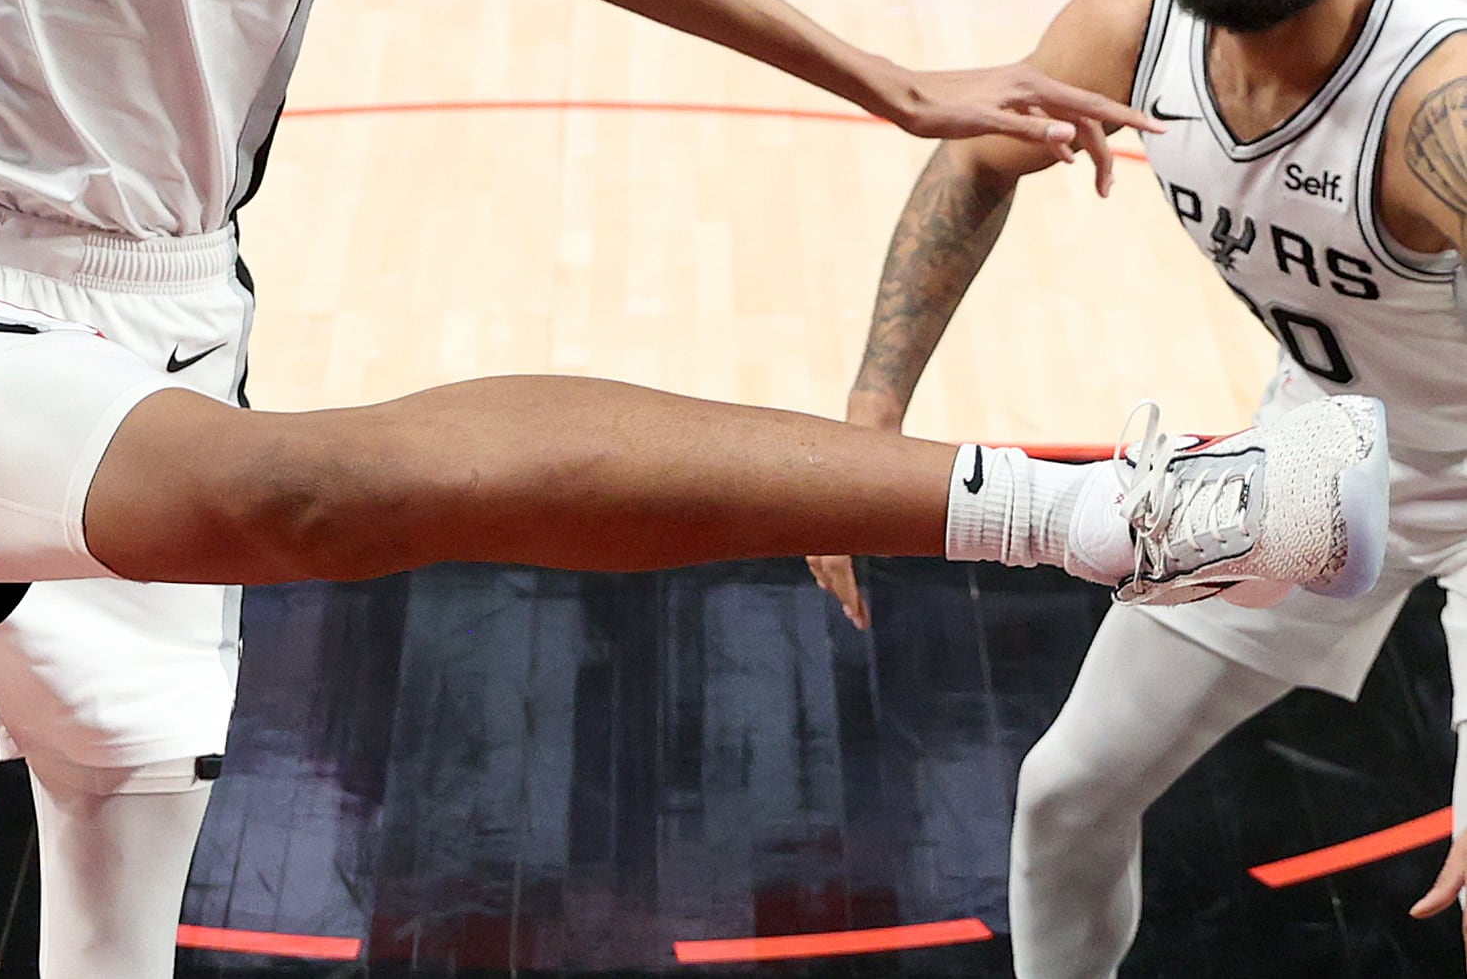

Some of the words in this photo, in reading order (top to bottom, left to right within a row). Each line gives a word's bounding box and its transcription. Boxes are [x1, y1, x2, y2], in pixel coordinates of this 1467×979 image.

[1284, 163, 1344, 203] Self.
[1159, 179, 1380, 301] PURS
[1228, 282, 1357, 384] 0
